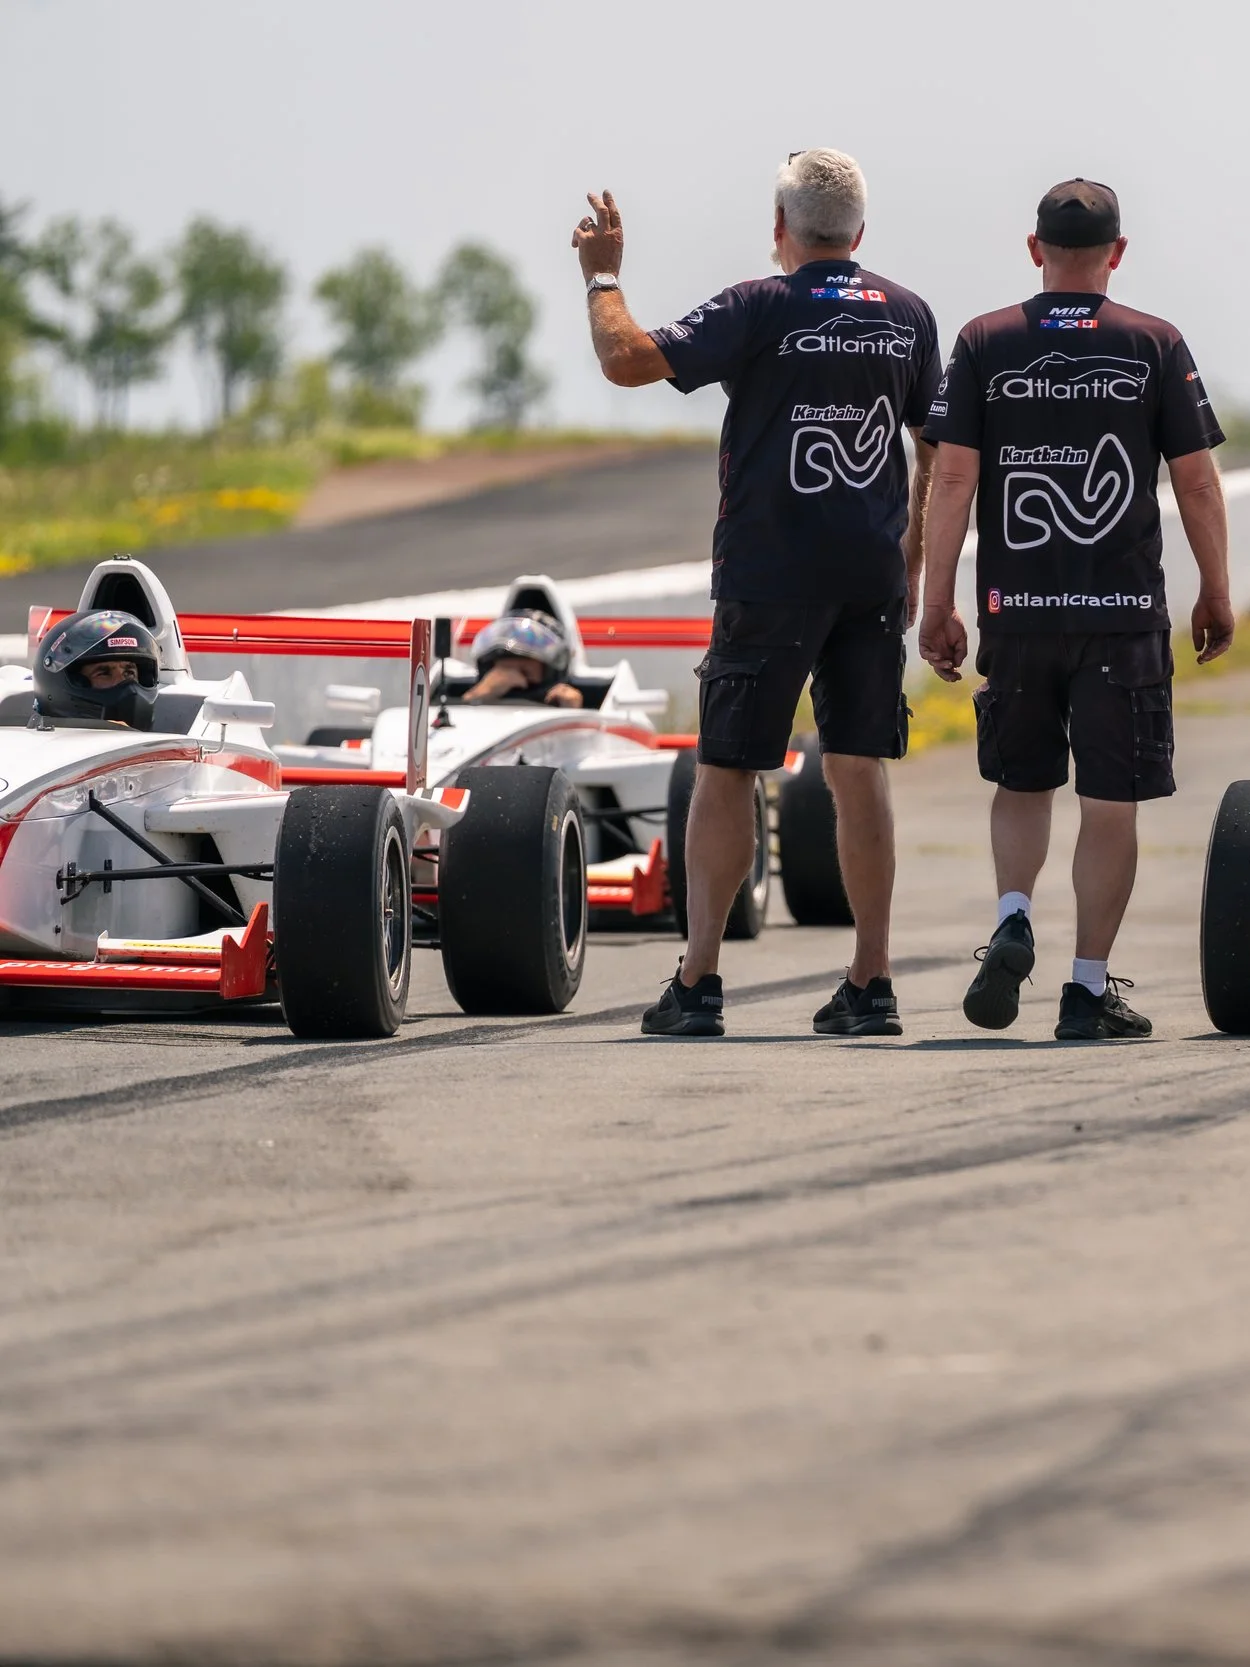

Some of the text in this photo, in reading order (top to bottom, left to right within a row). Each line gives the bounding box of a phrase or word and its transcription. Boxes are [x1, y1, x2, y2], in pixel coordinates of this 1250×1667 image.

[826, 275, 862, 285] MIR
[1049, 307, 1091, 315] MIR
[791, 404, 865, 421] Kartbahn
[999, 446, 1088, 465] Kartbahn
[109, 638, 137, 646] SIMPSON
[416, 684, 425, 749] 7
[0, 961, 220, 974] programm
